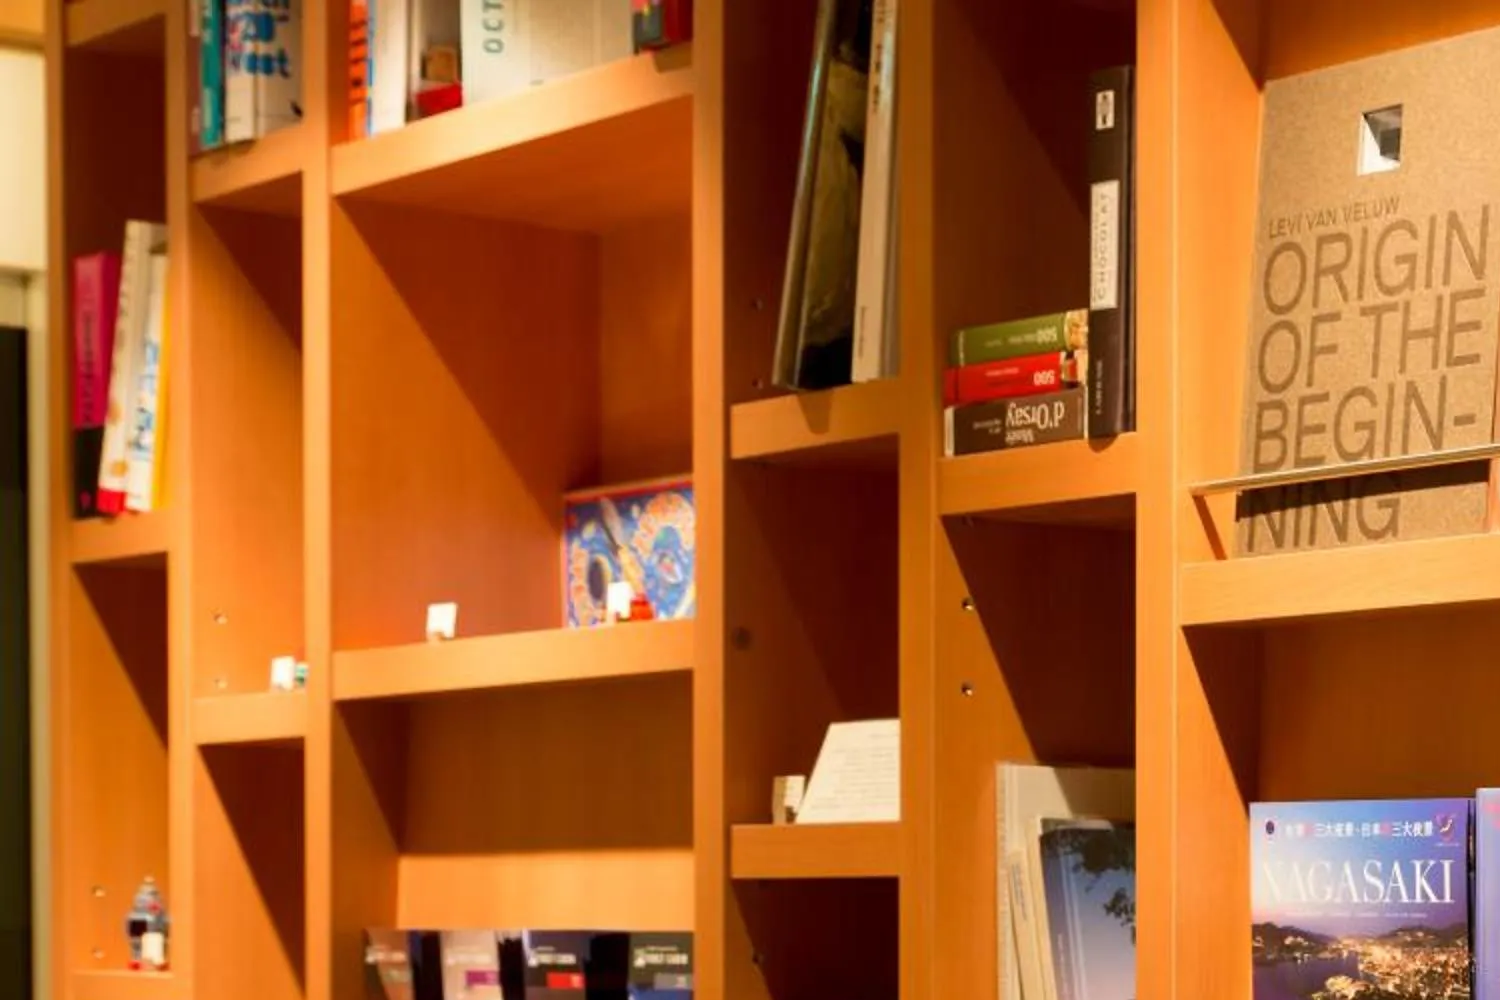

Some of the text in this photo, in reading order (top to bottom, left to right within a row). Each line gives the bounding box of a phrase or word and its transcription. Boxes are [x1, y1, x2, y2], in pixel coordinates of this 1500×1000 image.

[1268, 197, 1400, 239] LEVI VAN VELUW
[1263, 204, 1490, 315] ORIGIN
[1257, 285, 1486, 394] OF THE
[1005, 401, 1065, 429] d'Orsay
[1253, 375, 1476, 472] BEGIN-
[1246, 472, 1402, 553] NING
[1263, 859, 1456, 905] NAGASAKI
